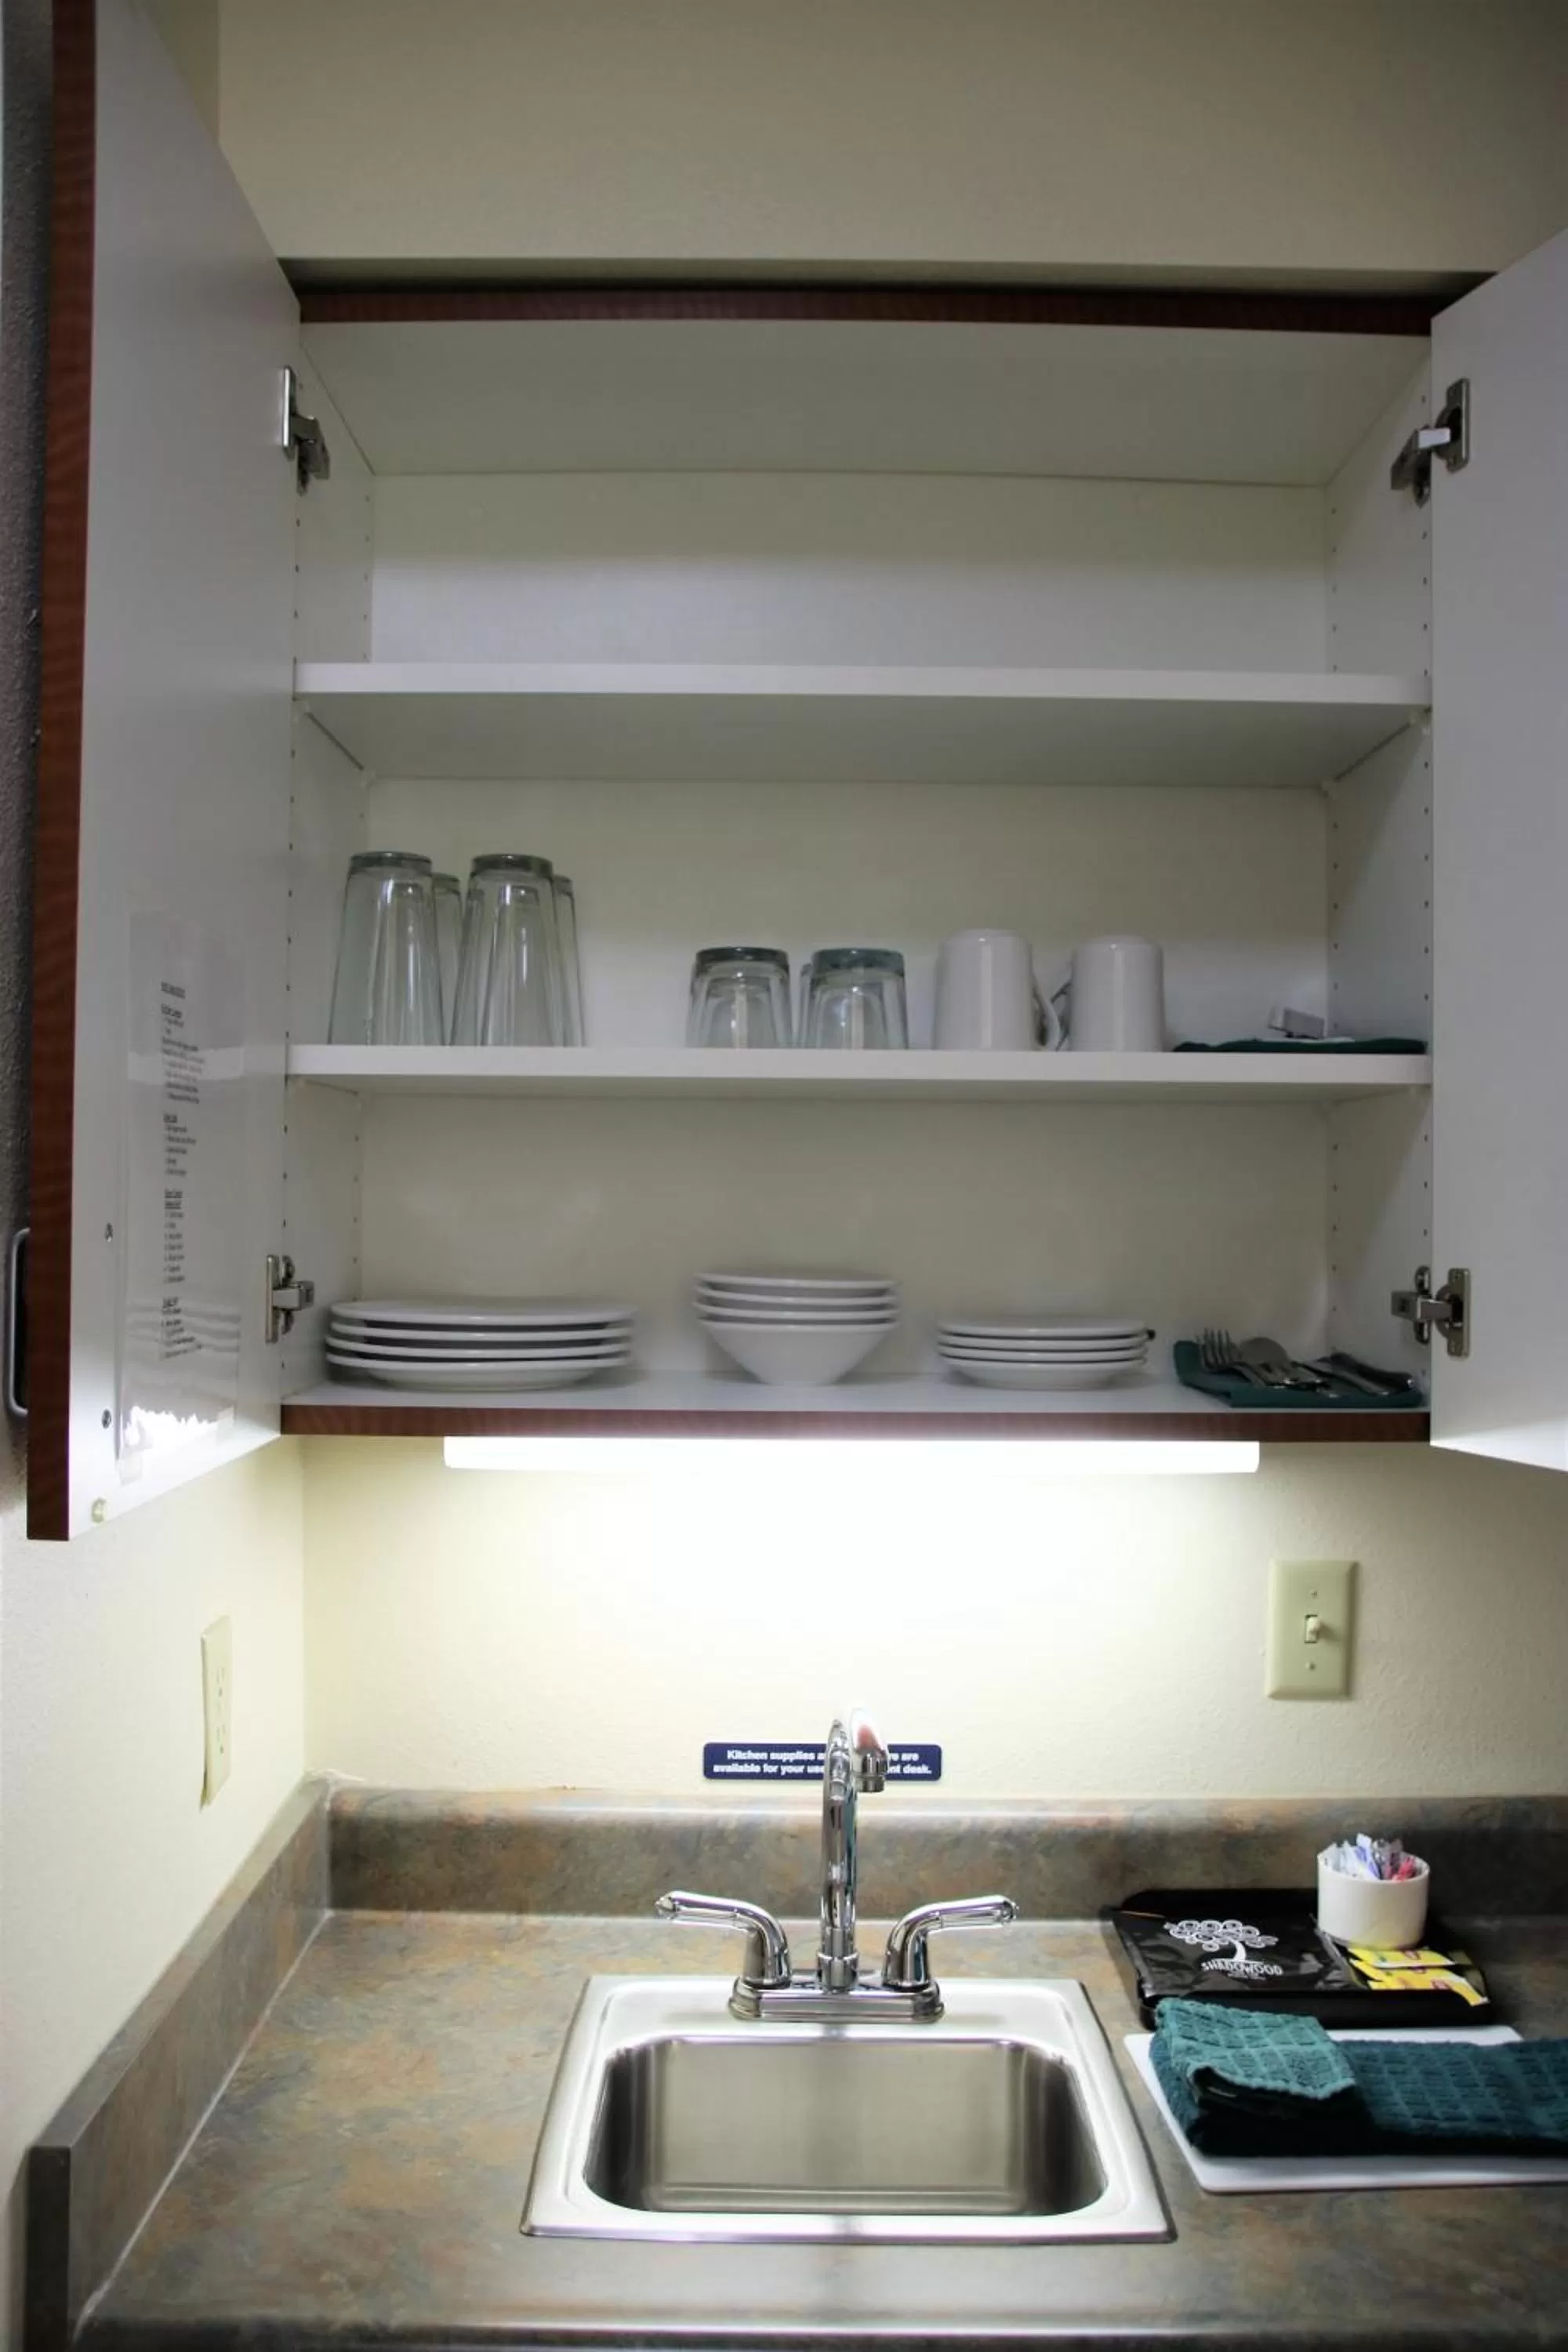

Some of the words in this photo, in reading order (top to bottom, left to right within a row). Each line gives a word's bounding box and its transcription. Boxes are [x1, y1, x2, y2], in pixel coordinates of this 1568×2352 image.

[727, 1749, 768, 1760] Kitchen
[769, 1750, 815, 1762] supplies
[901, 1752, 920, 1762] are
[713, 1763, 761, 1773] available
[763, 1763, 779, 1773] for
[780, 1765, 805, 1776] your
[902, 1763, 932, 1773] desk.
